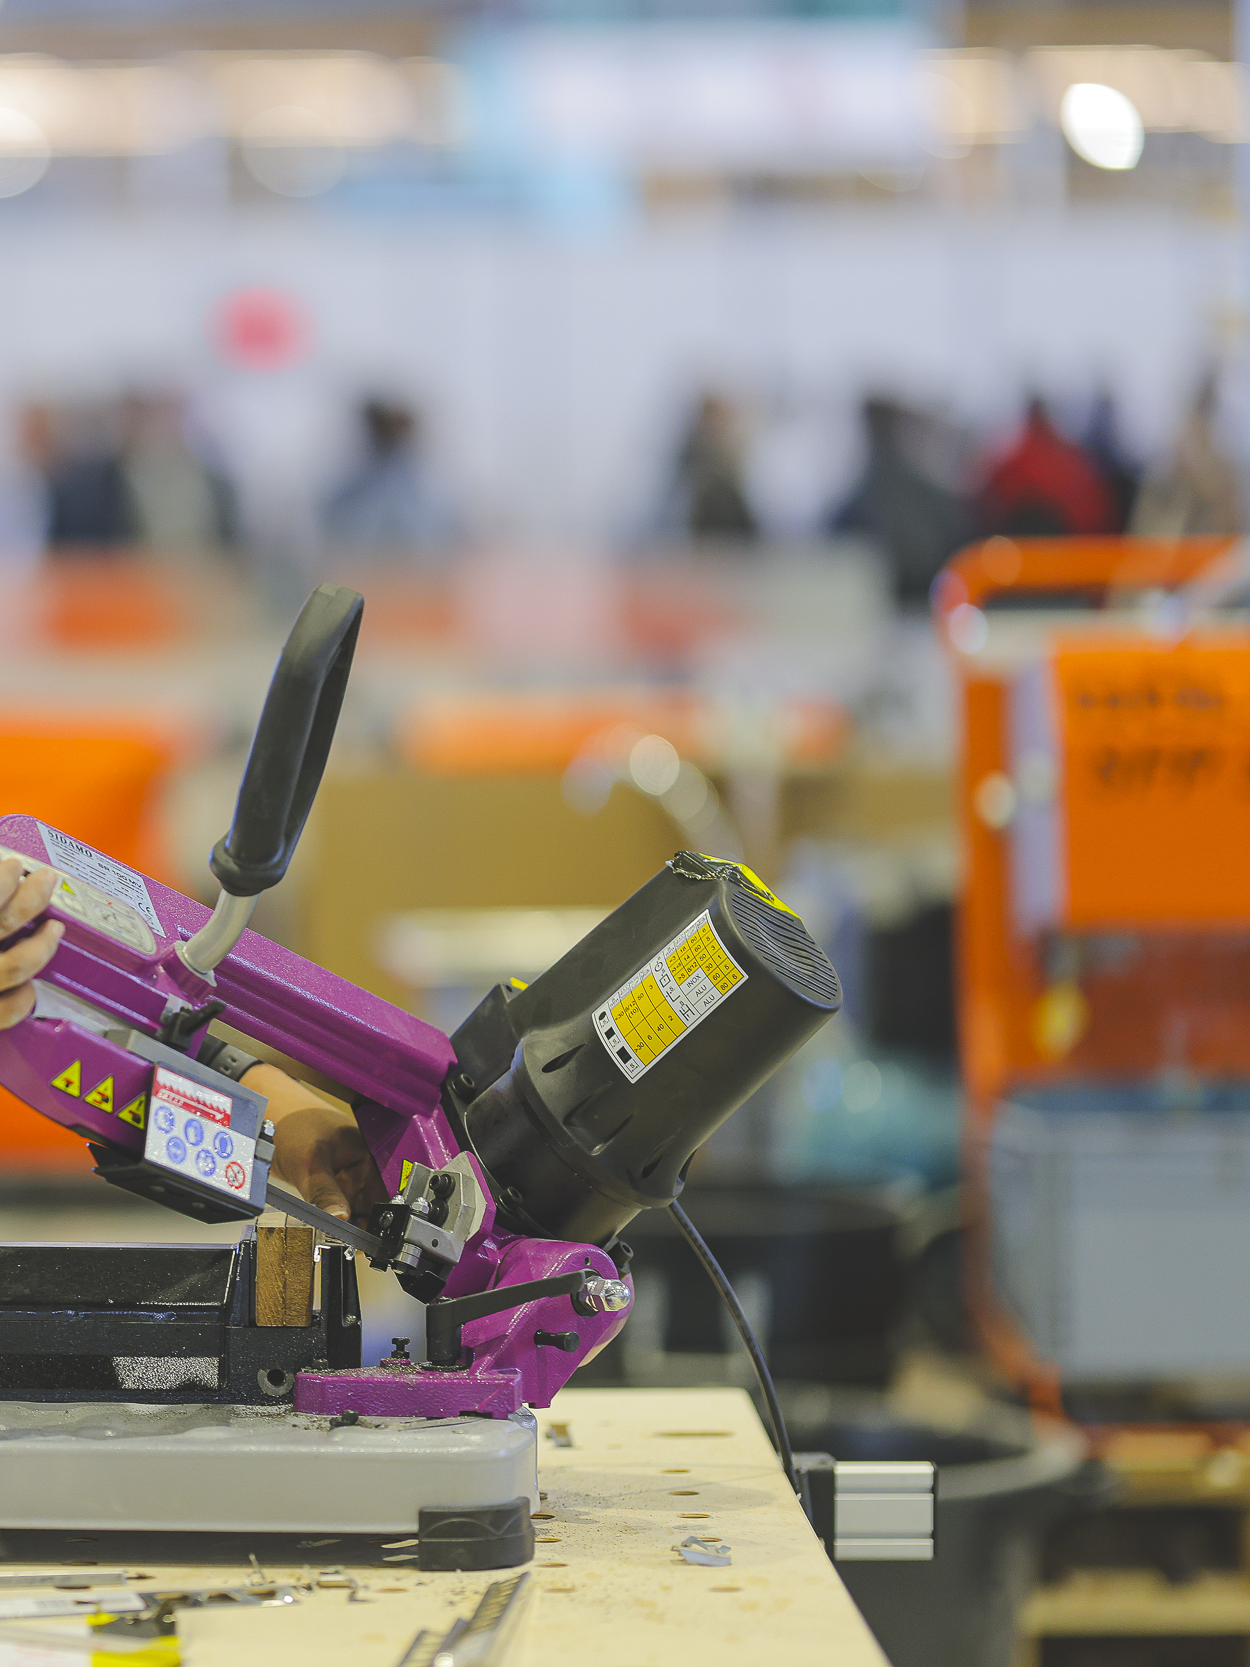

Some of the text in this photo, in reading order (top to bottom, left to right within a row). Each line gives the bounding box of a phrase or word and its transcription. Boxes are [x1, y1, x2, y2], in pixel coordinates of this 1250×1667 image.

[48, 830, 93, 858] SIDAMO
[686, 973, 701, 988] INOX
[705, 963, 713, 971] 30
[695, 985, 707, 997] ALU
[712, 972, 720, 980] 60
[703, 994, 715, 1007] ALU
[720, 982, 728, 990] 80
[634, 1042, 644, 1052] >30
[657, 1023, 664, 1031] 40
